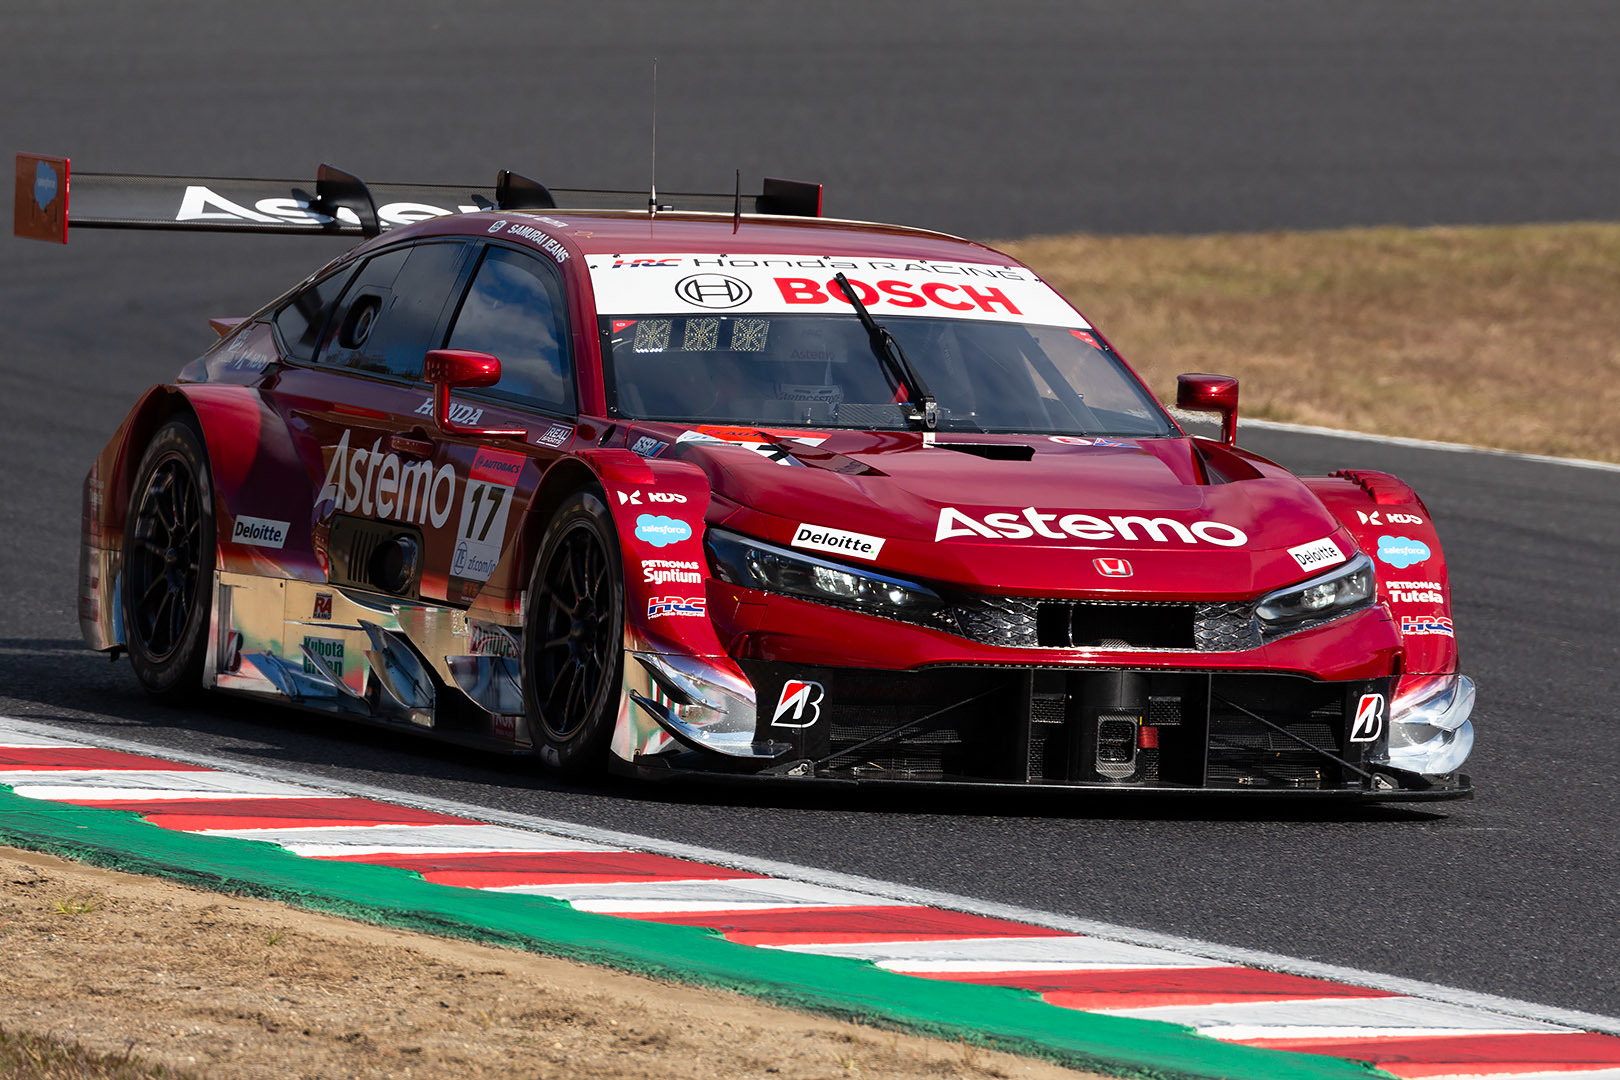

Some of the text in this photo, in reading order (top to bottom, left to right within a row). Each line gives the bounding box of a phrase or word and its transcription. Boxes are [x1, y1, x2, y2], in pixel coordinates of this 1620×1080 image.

[507, 224, 569, 264] SAMURAI JEANS
[612, 258, 1026, 281] HRC Honda RACING
[773, 277, 1023, 315] BOSCH
[414, 397, 484, 425] HNDA
[546, 427, 569, 441] REAL
[482, 458, 521, 474] AUTOBACS
[313, 429, 456, 529] Astemo
[466, 484, 506, 541] 17
[235, 522, 283, 542] Deloitte.
[641, 525, 687, 535] salesforce
[935, 506, 1248, 547] Astemo
[797, 529, 875, 554] Deloitte.
[1383, 546, 1426, 556] salesforce
[641, 560, 699, 570] PETRONAS
[643, 568, 701, 584] Syntium
[1386, 581, 1442, 590] PETRONAS
[647, 596, 706, 616] HRC
[1388, 590, 1444, 604] Tutela
[1401, 616, 1454, 633] HRC
[304, 637, 344, 657] Kubota
